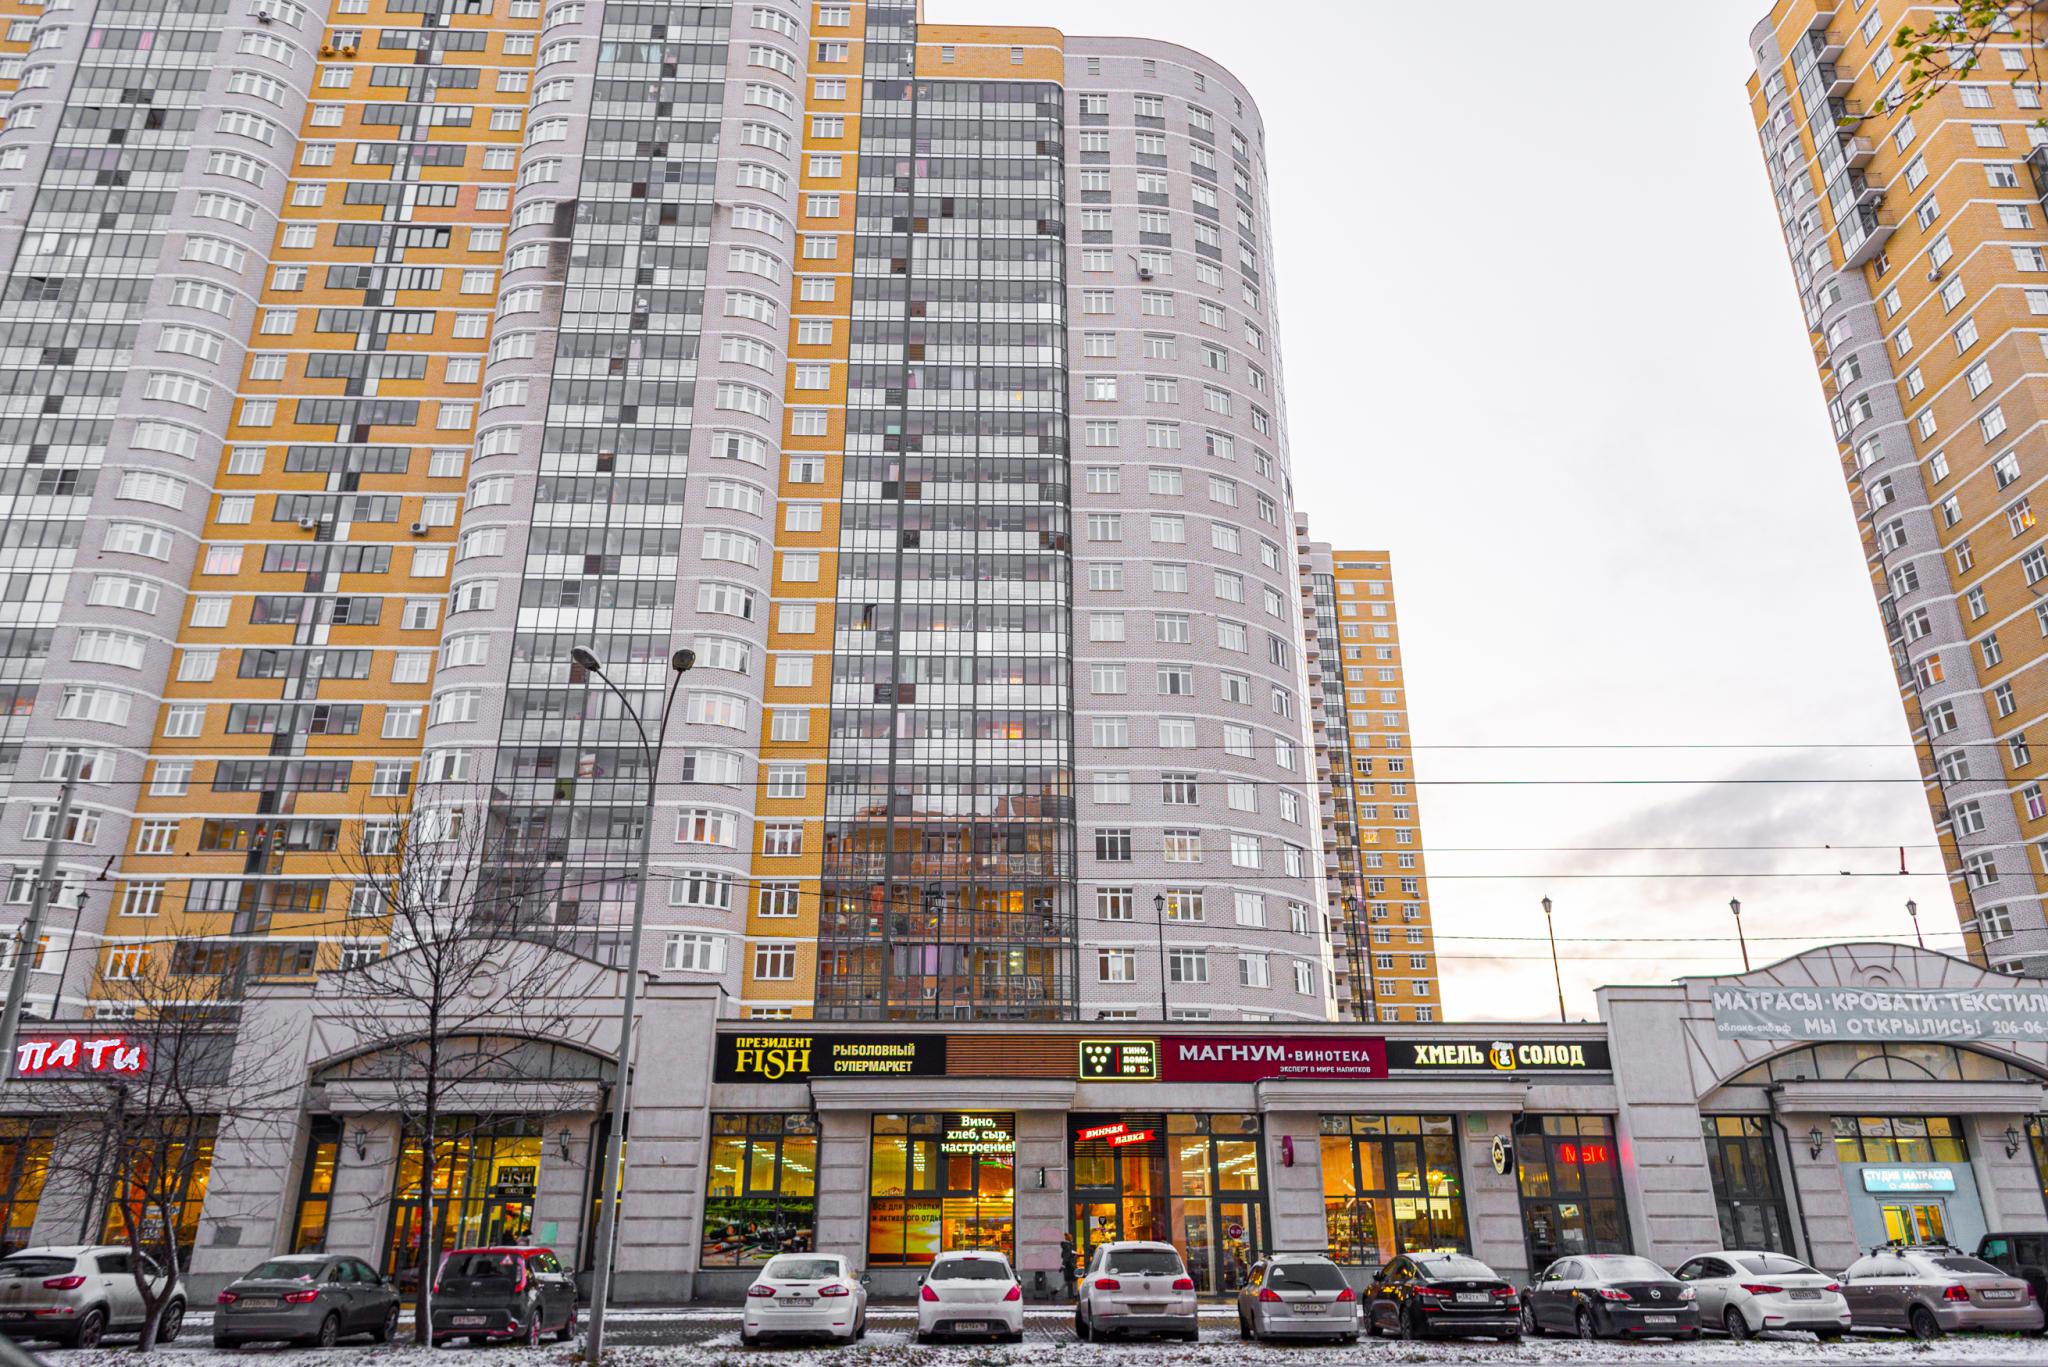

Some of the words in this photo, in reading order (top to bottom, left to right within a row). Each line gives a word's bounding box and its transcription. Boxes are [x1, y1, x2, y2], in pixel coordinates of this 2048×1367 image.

[1713, 992, 1823, 1012] МАТРАСЫ
[1831, 992, 1938, 1012] КРОВАТИ
[1804, 1018, 1837, 1034] МЫ
[1847, 1018, 1982, 1035] ОТКРЫЛИСЬ!
[1992, 1020, 2048, 1034] 206-06-
[736, 1037, 812, 1048] ПРЕЗИДЕНТ
[833, 1043, 915, 1056] РЫБОЛОВНЫЙ
[1179, 1045, 1286, 1061] МАГНУМ
[1295, 1051, 1370, 1062] ВИНОТЕКА
[1413, 1045, 1485, 1065] ХМЕЛЬ
[1519, 1045, 1585, 1067] СОЛОД
[735, 1049, 812, 1080] FISH
[834, 1060, 912, 1072] СУПЕРМАРКЕТ
[961, 1115, 996, 1128] Вино,
[947, 1128, 979, 1141] хлеб,
[982, 1130, 1010, 1142] сыр,
[1085, 1125, 1123, 1139] винная
[1114, 1132, 1145, 1145] лавка
[941, 1140, 1016, 1154] настроение!
